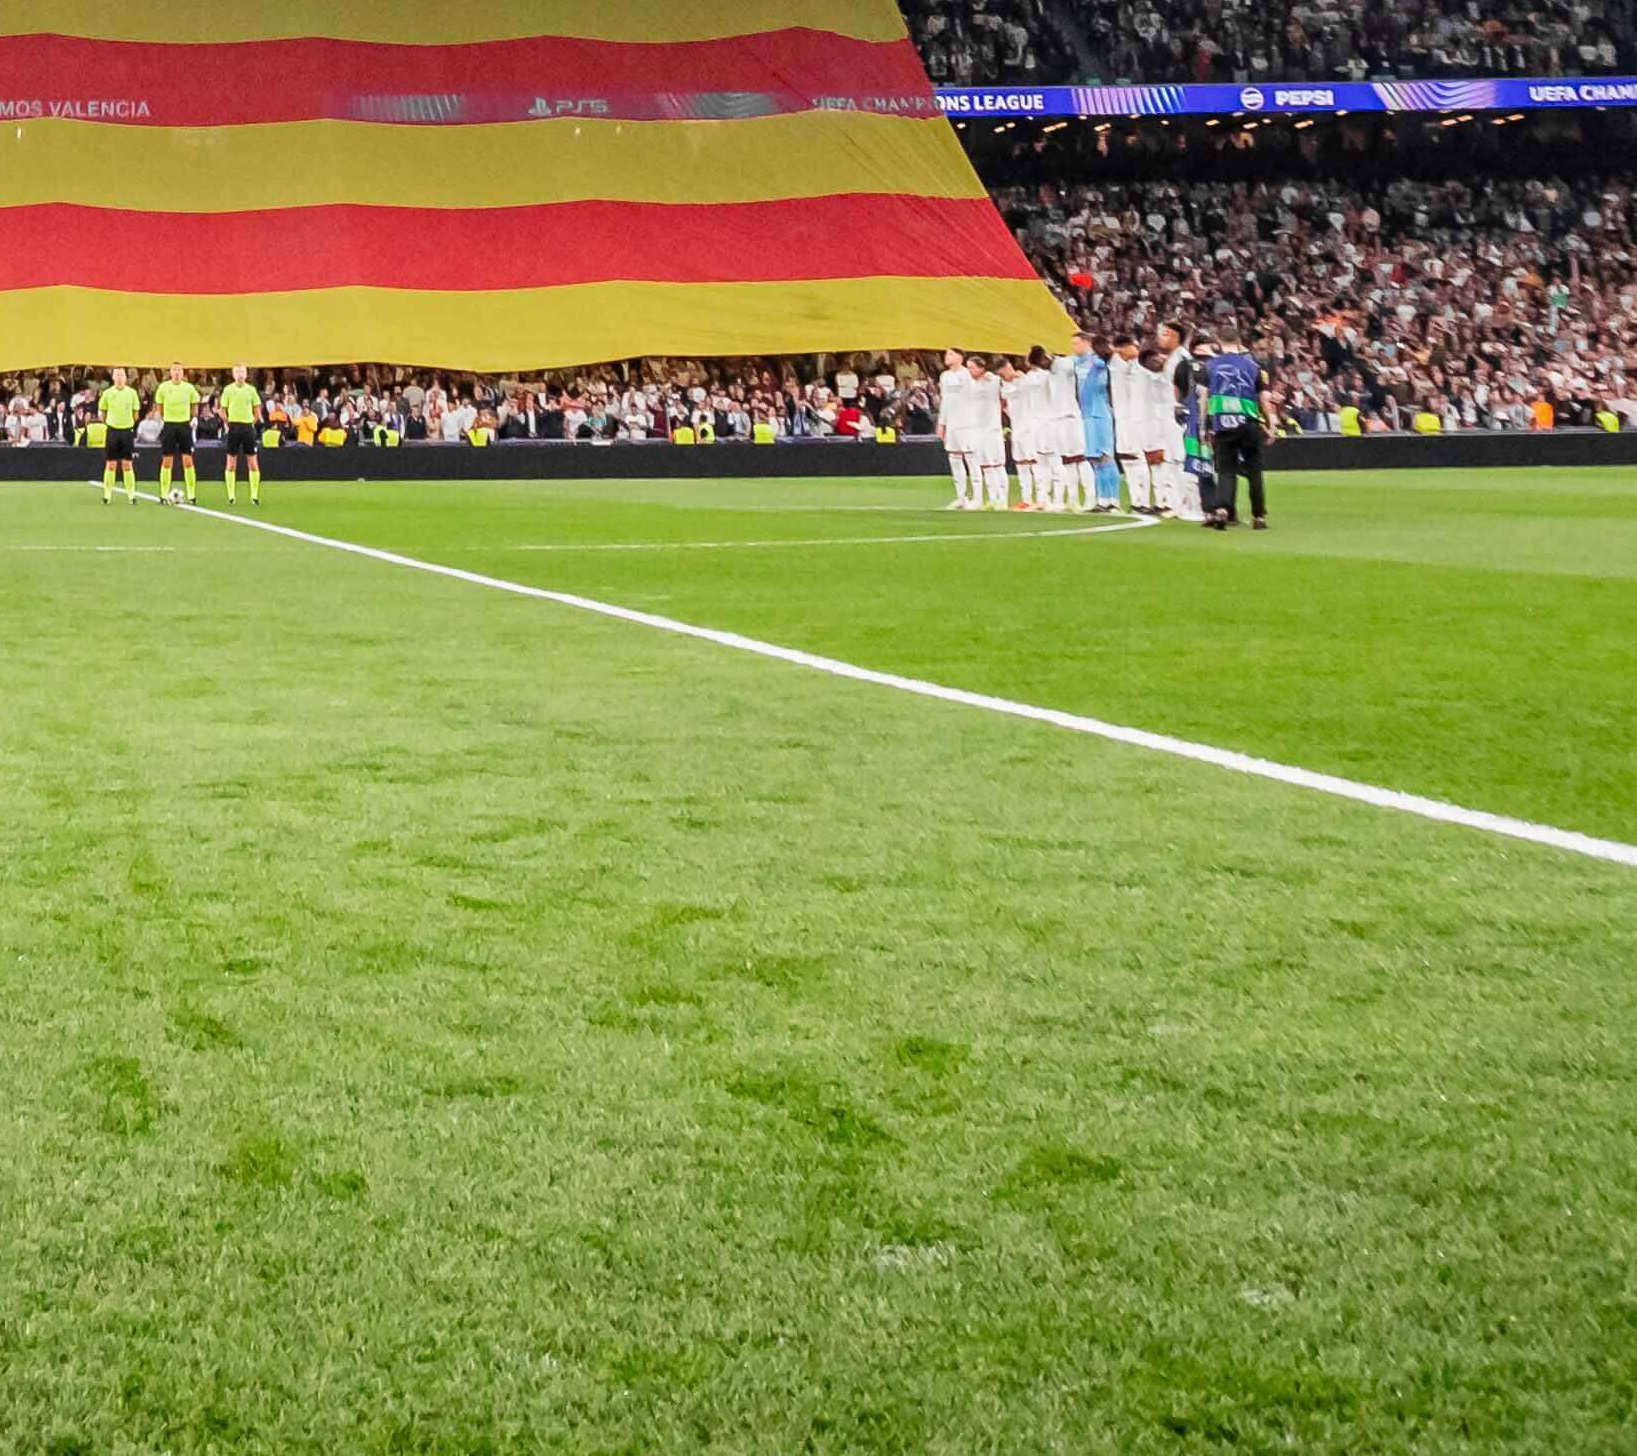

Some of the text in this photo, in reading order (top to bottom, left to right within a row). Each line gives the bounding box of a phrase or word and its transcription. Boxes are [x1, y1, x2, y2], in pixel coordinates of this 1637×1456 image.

[1274, 90, 1334, 106] PEPSI
[1529, 86, 1578, 102] UEFA
[49, 100, 150, 117] VALENCIA
[556, 99, 607, 114] PS5
[972, 94, 1044, 111] LEAGUE
